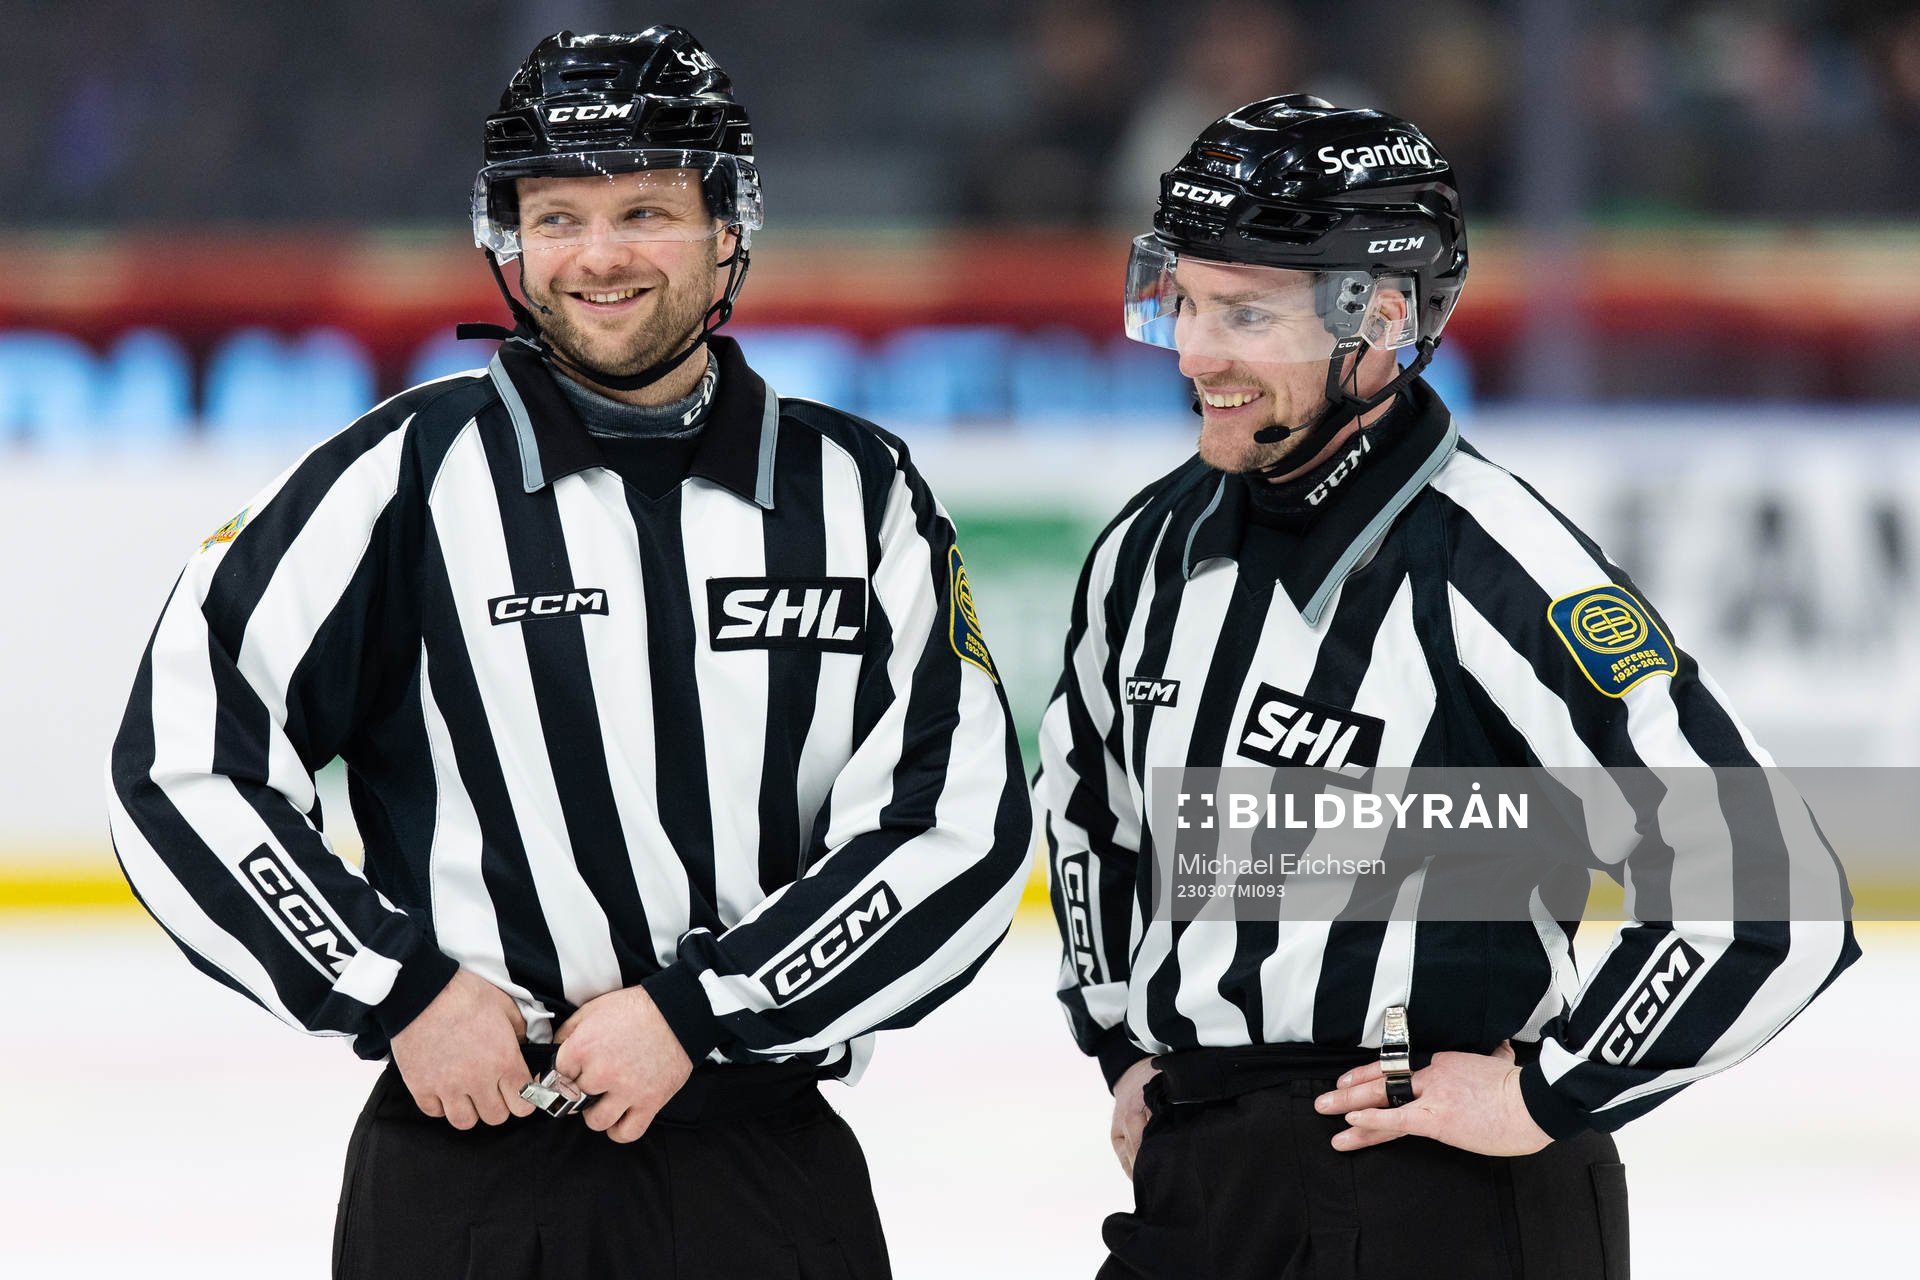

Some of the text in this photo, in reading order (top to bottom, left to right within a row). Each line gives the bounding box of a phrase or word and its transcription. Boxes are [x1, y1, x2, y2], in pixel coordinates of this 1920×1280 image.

[549, 103, 633, 123] CCM
[1171, 182, 1236, 208] CCM
[1367, 236, 1425, 254] CCM
[1338, 341, 1360, 349] CCM
[1304, 434, 1371, 506] CCM
[494, 591, 603, 619] CCM
[715, 588, 860, 641] SHL
[1610, 649, 1658, 673] REFEREE
[1612, 657, 1668, 683] 1922-2022
[1126, 680, 1176, 702] CCM
[1243, 700, 1370, 780] SHL
[249, 856, 355, 974] CCM
[1064, 861, 1097, 986] CCM
[775, 888, 890, 996] CCM
[1601, 945, 1691, 1066] CCM
